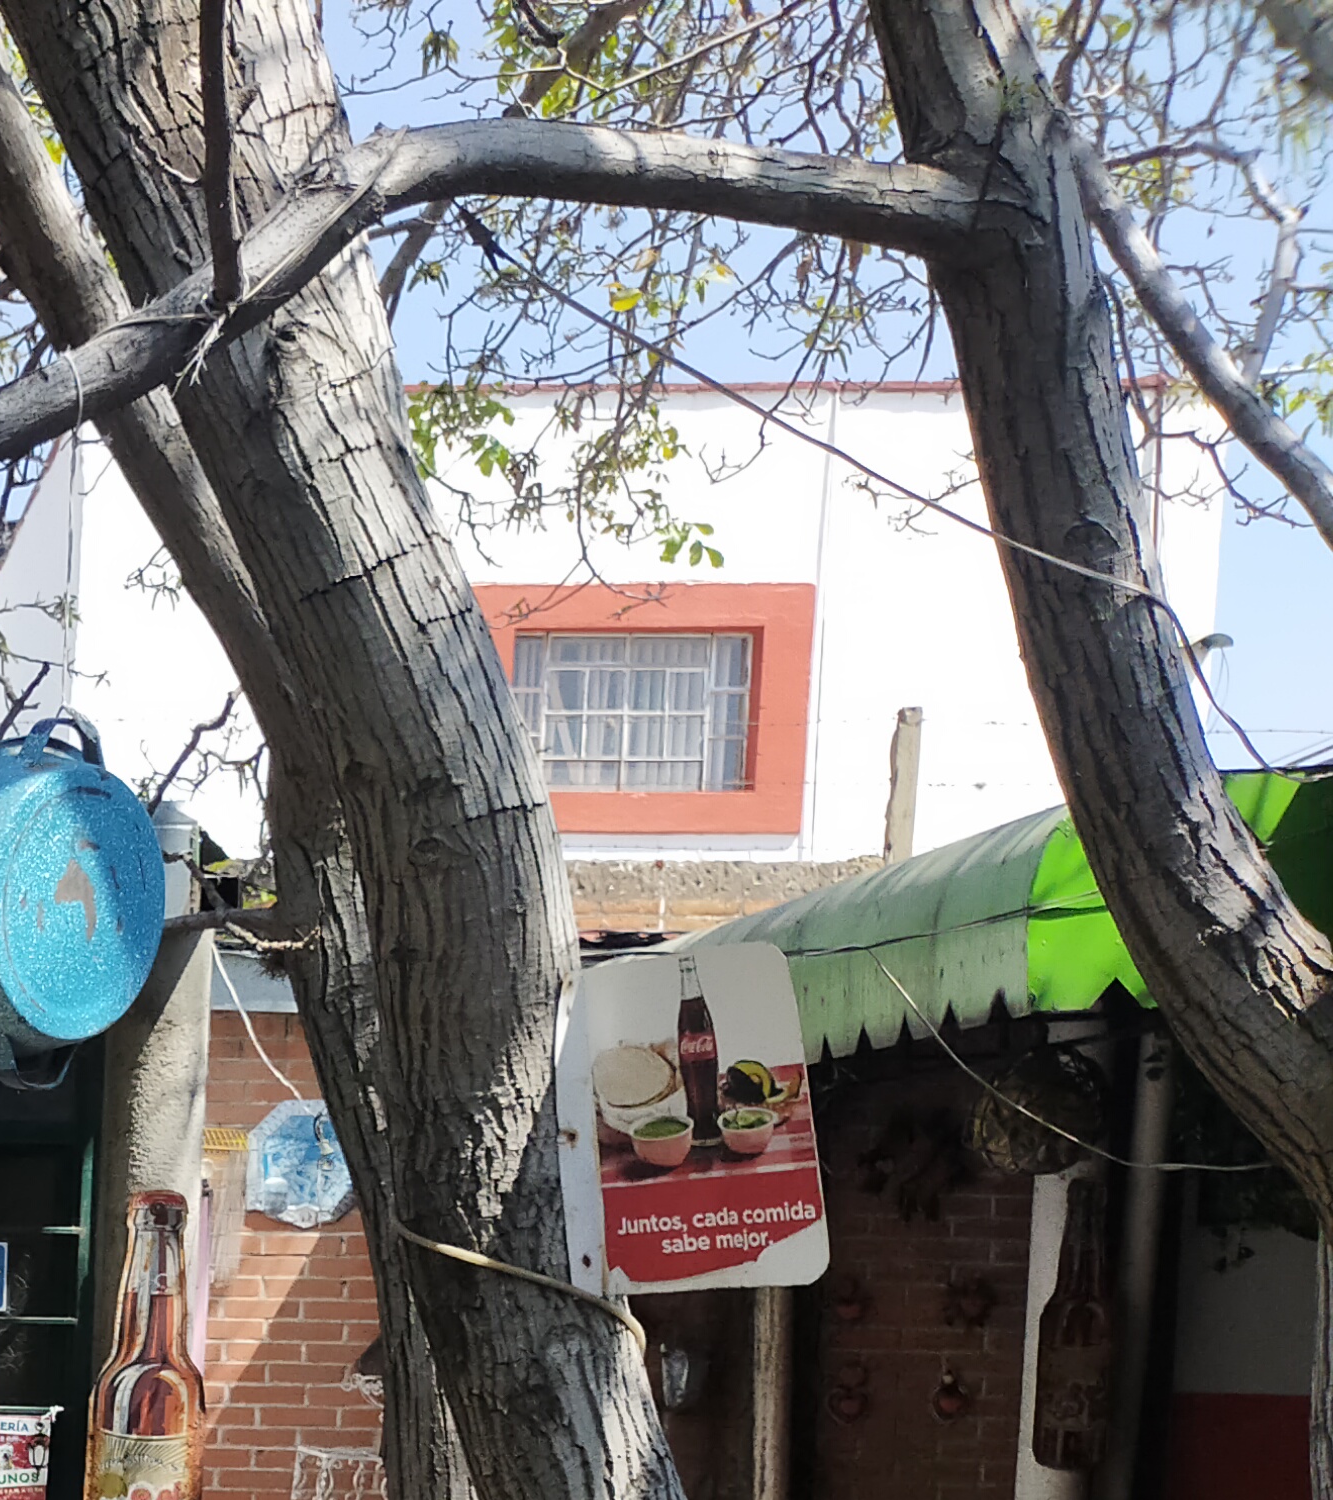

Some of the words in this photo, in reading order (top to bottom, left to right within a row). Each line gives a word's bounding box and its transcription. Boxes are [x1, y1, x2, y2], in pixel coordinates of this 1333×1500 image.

[616, 1213, 688, 1237] Juntos,
[691, 1206, 738, 1229] cada
[741, 1200, 817, 1226] comida
[661, 1231, 711, 1255] sabe
[715, 1228, 775, 1252] mejor.
